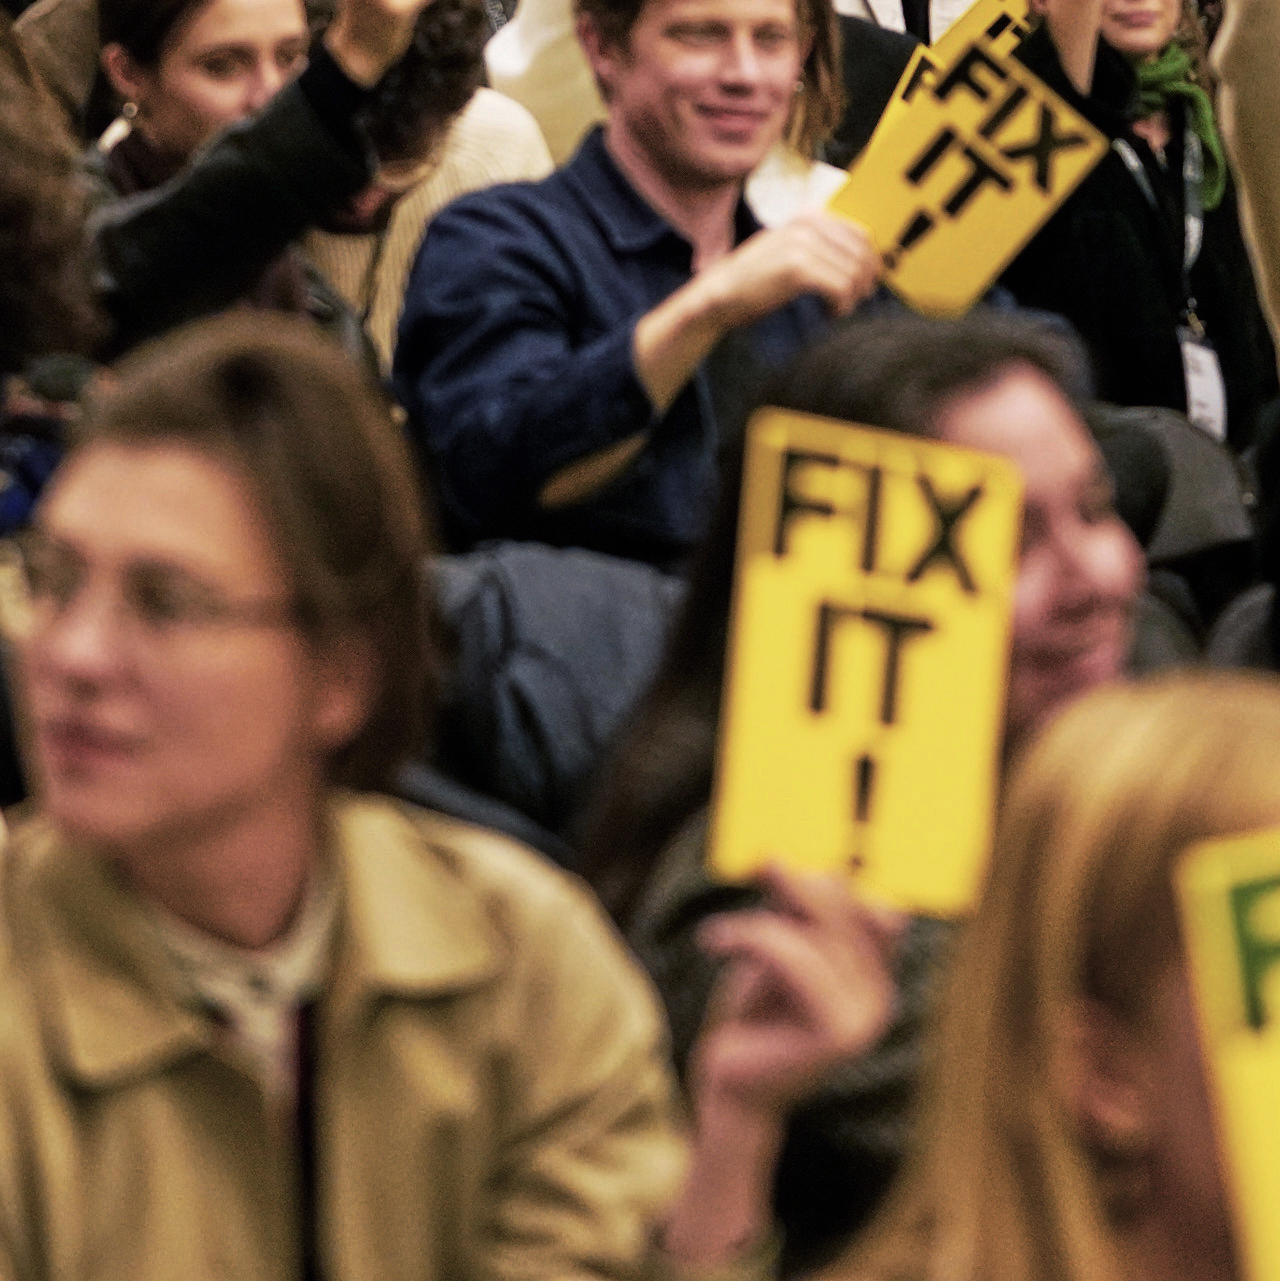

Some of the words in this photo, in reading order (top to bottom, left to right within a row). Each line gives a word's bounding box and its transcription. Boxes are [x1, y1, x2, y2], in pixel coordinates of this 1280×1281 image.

[904, 129, 1015, 218] IT
[937, 47, 1088, 196] FIX
[773, 448, 984, 597] FIX
[810, 599, 933, 724] IT
[851, 753, 876, 869] !
